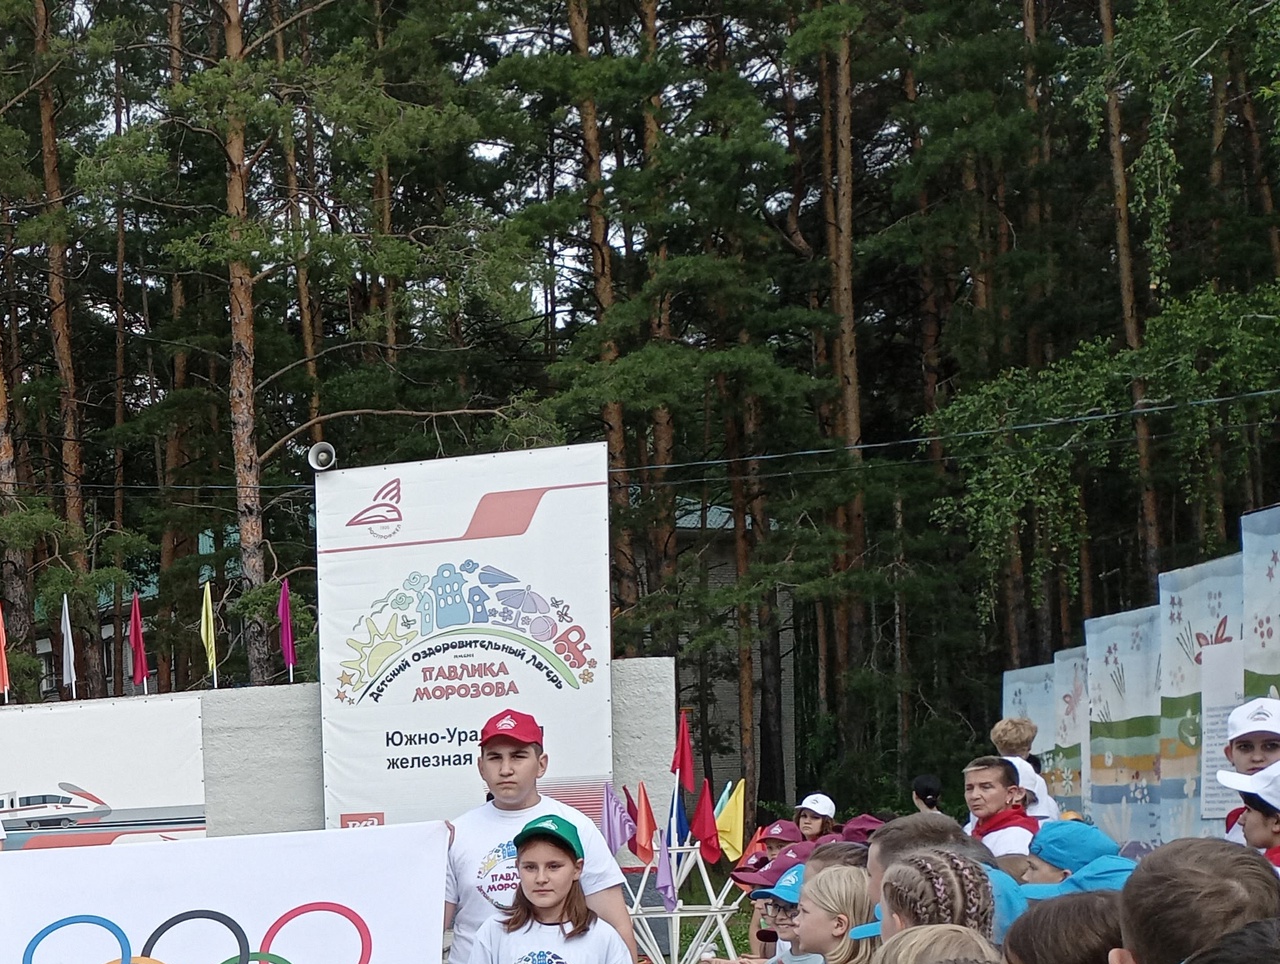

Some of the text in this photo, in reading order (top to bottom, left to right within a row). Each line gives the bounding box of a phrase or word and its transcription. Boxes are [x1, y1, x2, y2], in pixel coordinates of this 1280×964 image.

[369, 639, 564, 703] Детский Оздоровительный Лагерь
[421, 661, 510, 683] ПАВЛИКА
[412, 680, 520, 703] МОРОЗОВА
[387, 753, 473, 770] железная
[491, 872, 521, 882] ПАВЛ
[487, 883, 518, 893] МОРО
